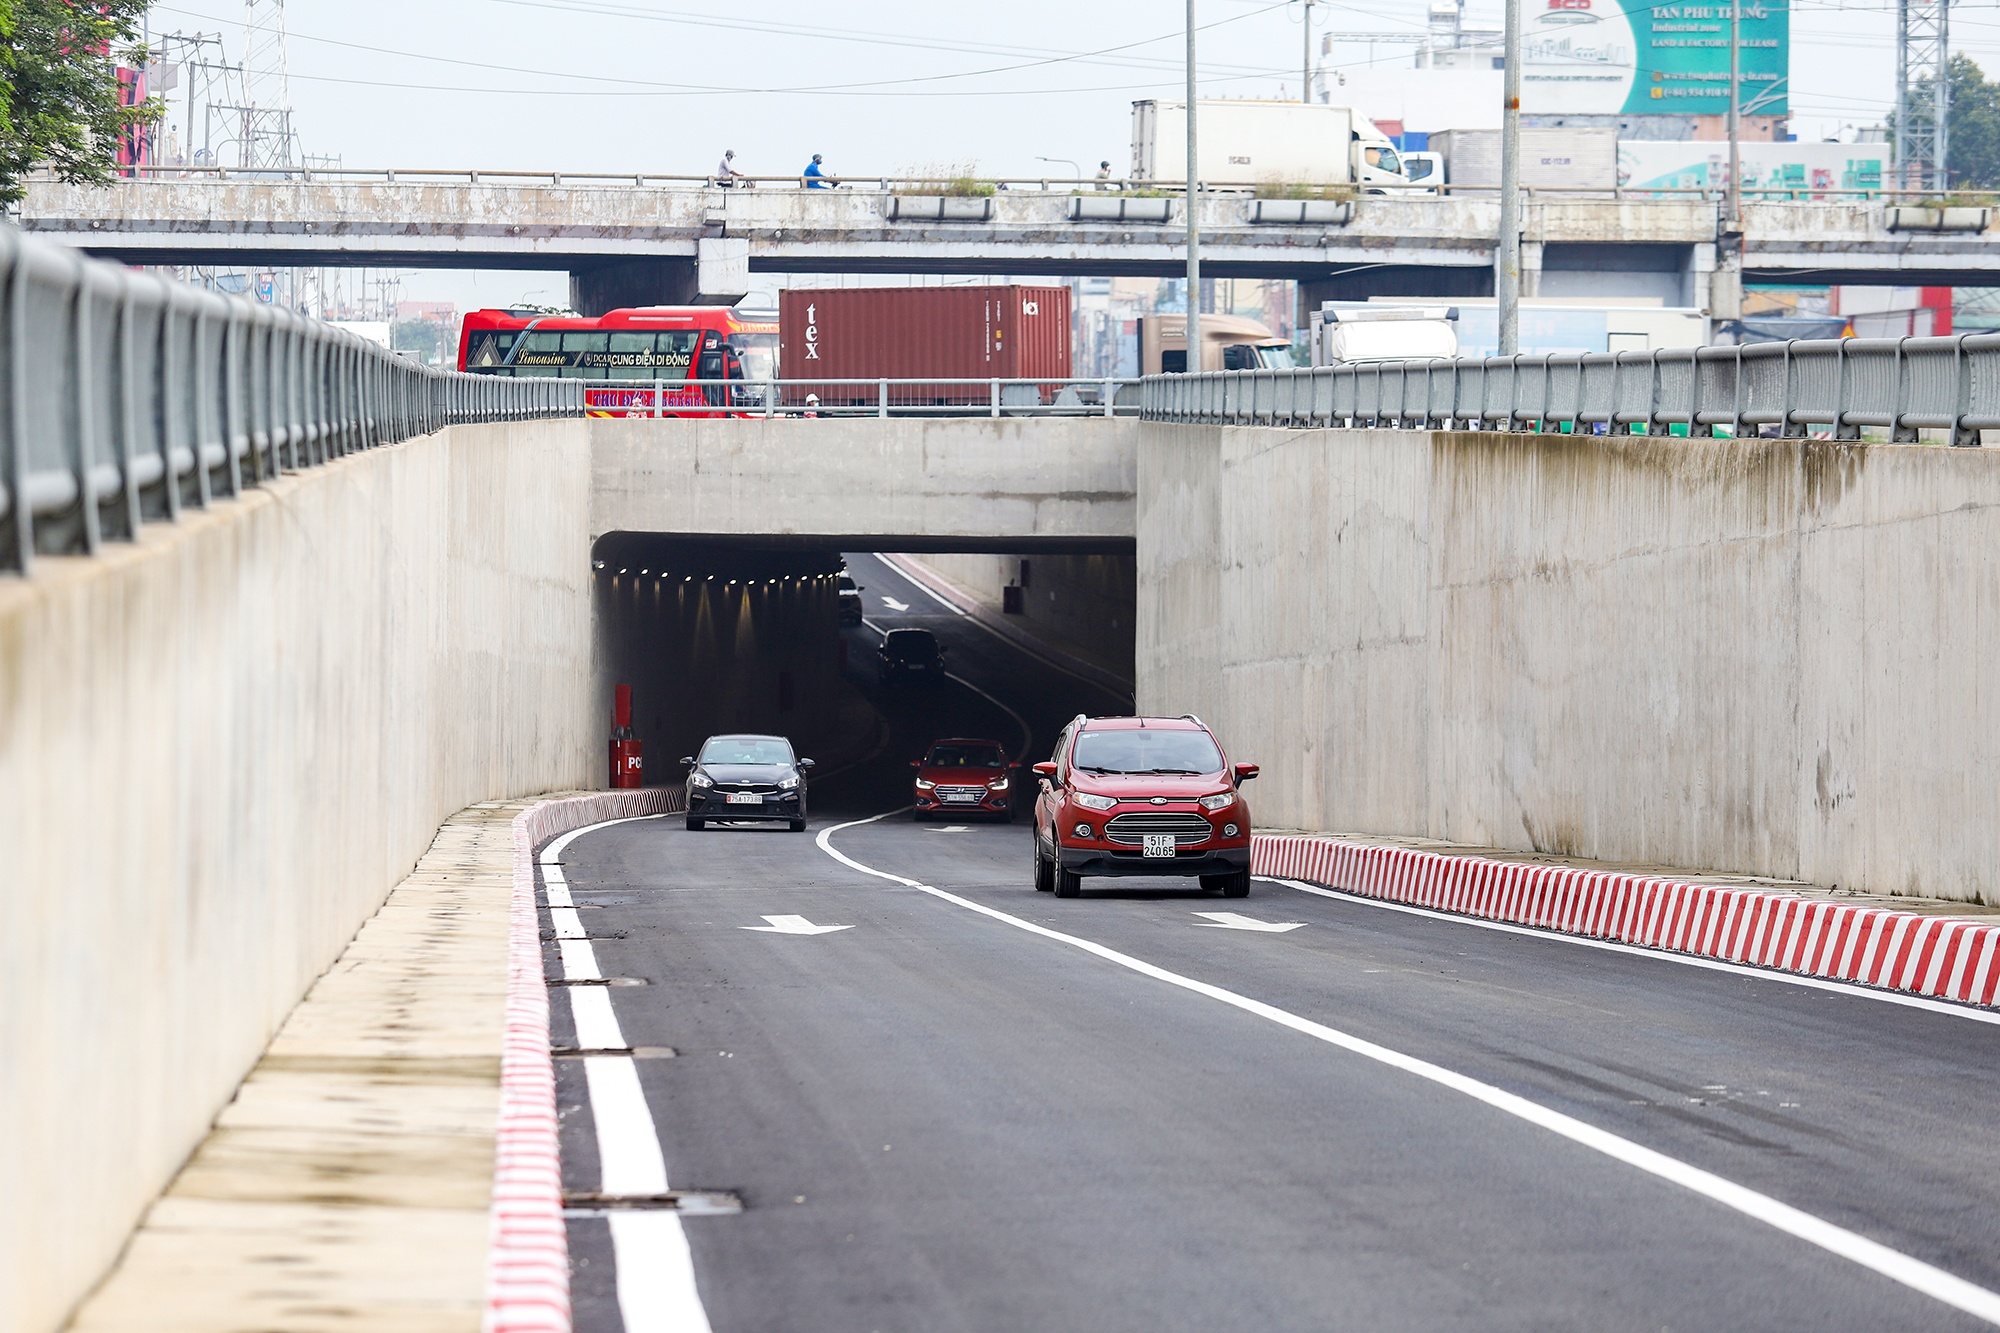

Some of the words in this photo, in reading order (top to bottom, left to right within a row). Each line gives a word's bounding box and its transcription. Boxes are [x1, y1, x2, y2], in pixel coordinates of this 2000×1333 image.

[1651, 7, 1680, 19] TAN
[1684, 7, 1713, 19] PHU
[1652, 23, 1698, 32] Industrial
[1651, 39, 1675, 47] LAND
[1687, 39, 1727, 47] FACTORY
[1730, 39, 1747, 47] OR
[1749, 39, 1778, 47] LEASE
[804, 302, 819, 360] tex
[517, 348, 567, 365] Limousine
[593, 354, 612, 363] DCAR
[611, 354, 634, 366] CUNG
[656, 354, 665, 366] DI
[1150, 835, 1168, 847] 51F
[1144, 846, 1174, 857] 240.65
